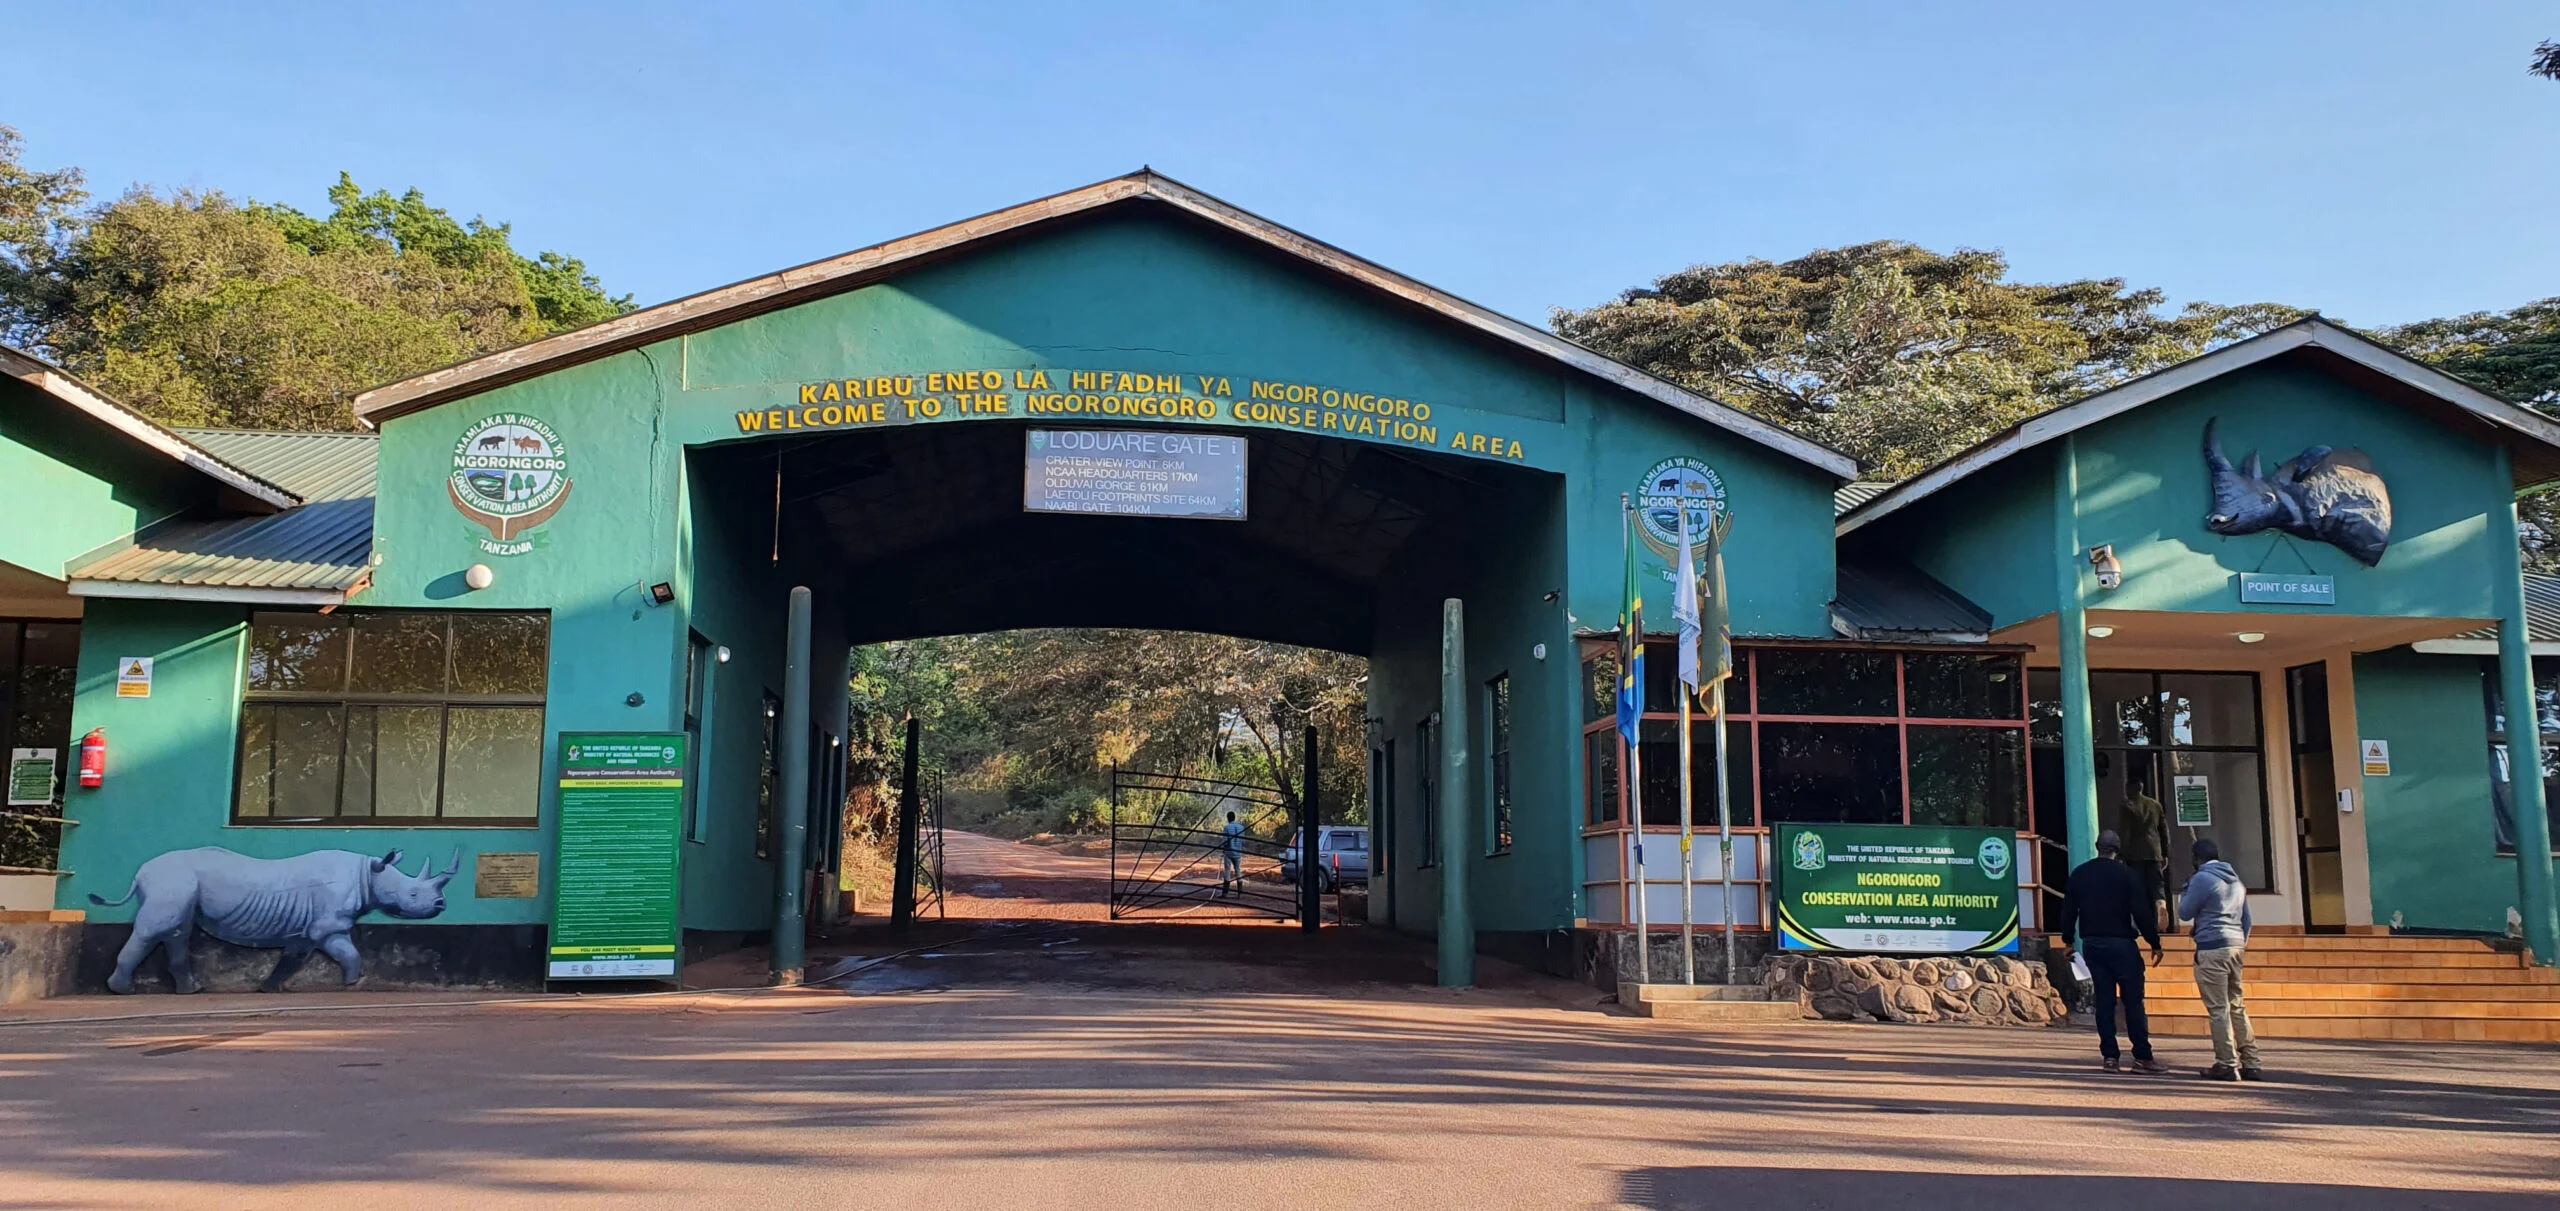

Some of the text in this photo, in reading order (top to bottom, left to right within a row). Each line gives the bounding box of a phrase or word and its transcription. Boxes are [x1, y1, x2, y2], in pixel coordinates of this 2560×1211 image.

[801, 371, 1431, 422] KARIBU ENEO LA HIFADHI YA NGORONGORO
[737, 394, 1524, 459] WELCOME TO THE NGORONGORO CONSERVATION AREA
[455, 414, 565, 457] MAMLAKA YA HIFADHI YA
[1050, 431, 1221, 455] LODUARE GATE
[454, 455, 566, 470] NGORONGORO
[1045, 455, 1185, 470] CRATER VIEW POINT 6KM
[1045, 466, 1198, 482] NCAA HEADQUARTERS 17KM
[1639, 458, 1726, 499] MAMLAKA YA HIFADHI YA
[452, 470, 564, 513] CONSERVATION AREA AUTHORITY
[1045, 478, 1168, 492] OLDUVAI GORGE 61KM
[1045, 490, 1216, 505] LAETOLI FOOTPRINTS SITE 64KM
[1045, 502, 1151, 514] NAABI GATE 104KM
[480, 539, 533, 555] TANZANIA
[2247, 582, 2330, 593] POINT OF SALE
[1885, 846, 1913, 854] REPUBLIC
[1857, 872, 1941, 887] NGORONGORO
[1802, 892, 1999, 909] CONSERVATION AREA AUTHORITY
[1845, 912, 1957, 927] web: www.ncaa.go.tz
